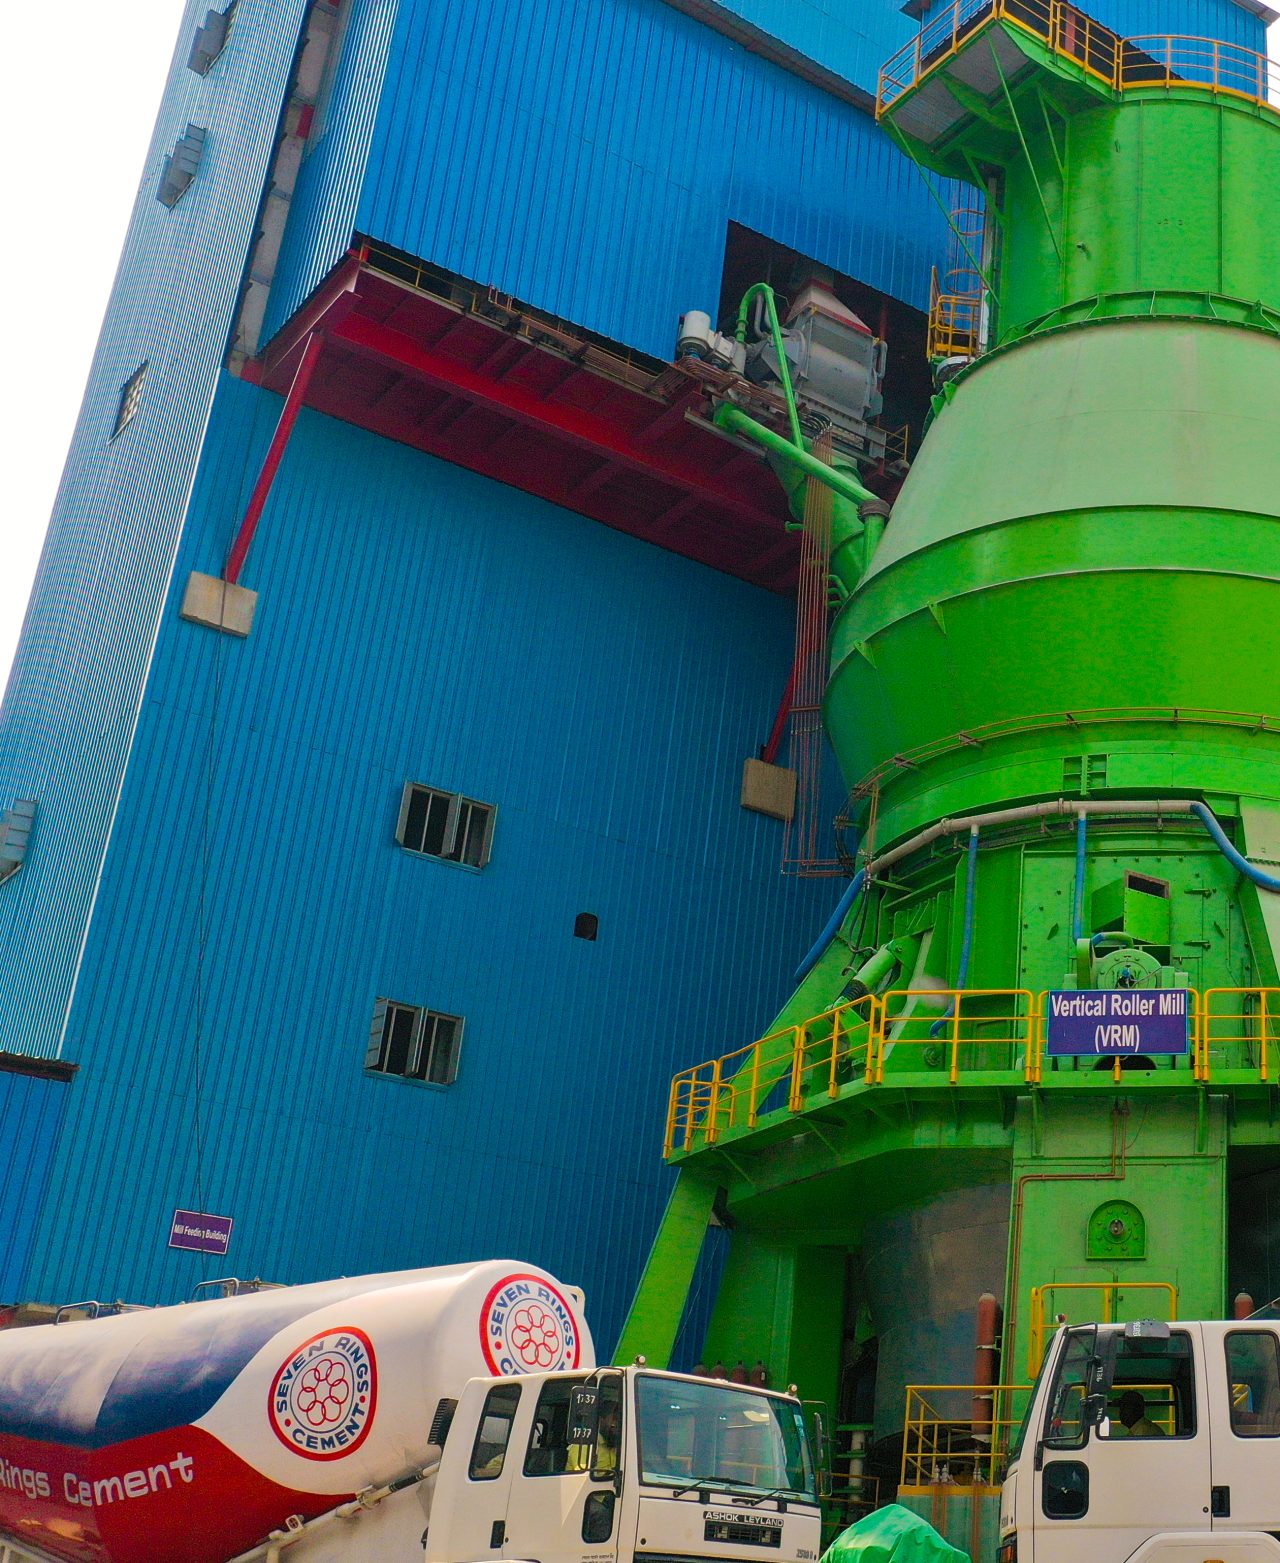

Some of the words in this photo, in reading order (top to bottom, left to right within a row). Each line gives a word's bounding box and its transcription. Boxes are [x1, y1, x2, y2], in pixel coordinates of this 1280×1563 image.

[1052, 994, 1106, 1017] Vertical
[1111, 994, 1156, 1016] Roller
[1159, 993, 1184, 1016] Mill
[1095, 1024, 1140, 1053] (VRM)
[173, 1224, 185, 1235] Mill
[184, 1225, 206, 1239] Feeding
[205, 1228, 227, 1244] Building
[490, 1283, 531, 1337] SEVEN
[537, 1286, 574, 1347] RINGS
[276, 1340, 325, 1414] SEVEN
[334, 1336, 369, 1393] RINGS
[292, 1402, 365, 1450] CEMENT
[573, 1427, 592, 1439] 1737
[63, 1452, 193, 1507] Cement
[705, 1511, 739, 1522] ASHOK
[743, 1515, 785, 1527] LEYLAND
